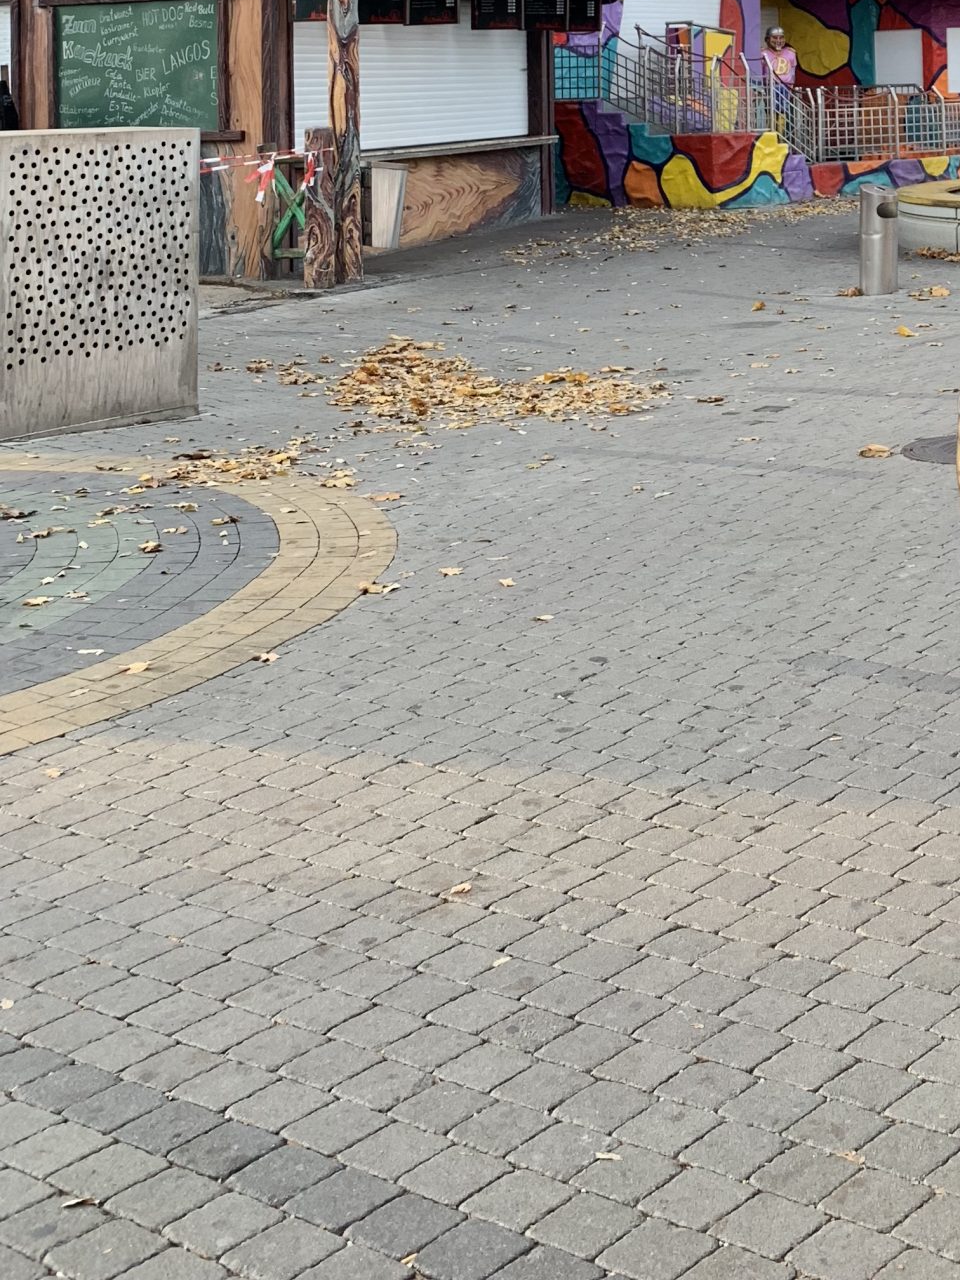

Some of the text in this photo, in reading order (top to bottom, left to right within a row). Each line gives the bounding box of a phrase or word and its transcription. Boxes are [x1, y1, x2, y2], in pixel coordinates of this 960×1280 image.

[142, 9, 160, 27] HOT
[162, 6, 184, 22] DOG
[198, 4, 214, 15] Bull
[62, 15, 97, 36] Zum
[62, 40, 134, 71] Kuckuck
[135, 67, 156, 82] BIER
[109, 79, 132, 90] Fanta
